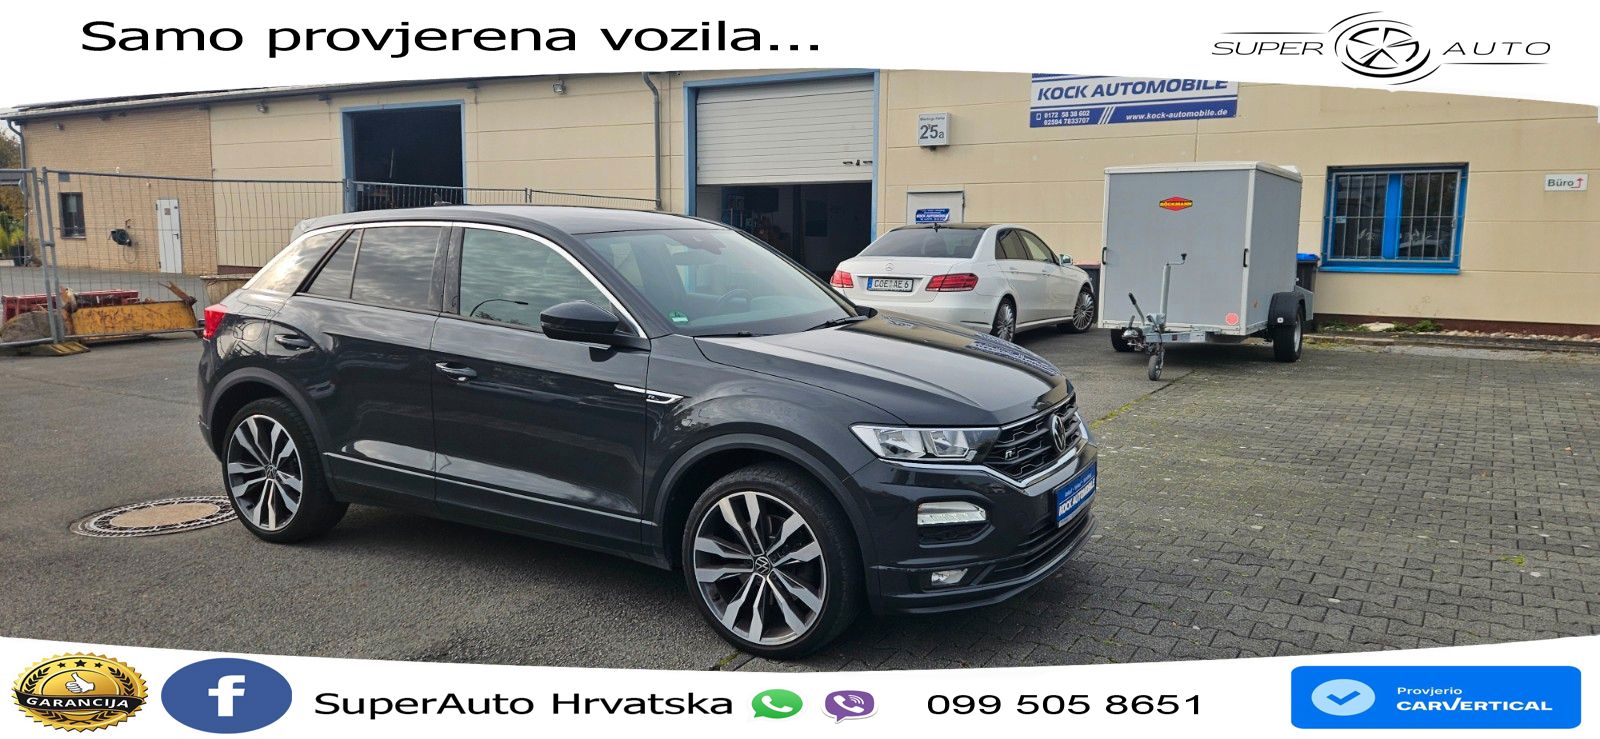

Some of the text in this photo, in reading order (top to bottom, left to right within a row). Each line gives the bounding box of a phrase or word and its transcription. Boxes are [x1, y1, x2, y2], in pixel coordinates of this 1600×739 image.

[1037, 78, 1229, 101] KOCK AUTOMOBILE
[1044, 111, 1059, 119] 0172
[1126, 108, 1228, 121] www.kock-automobile.de
[1547, 178, 1574, 187] Büro
